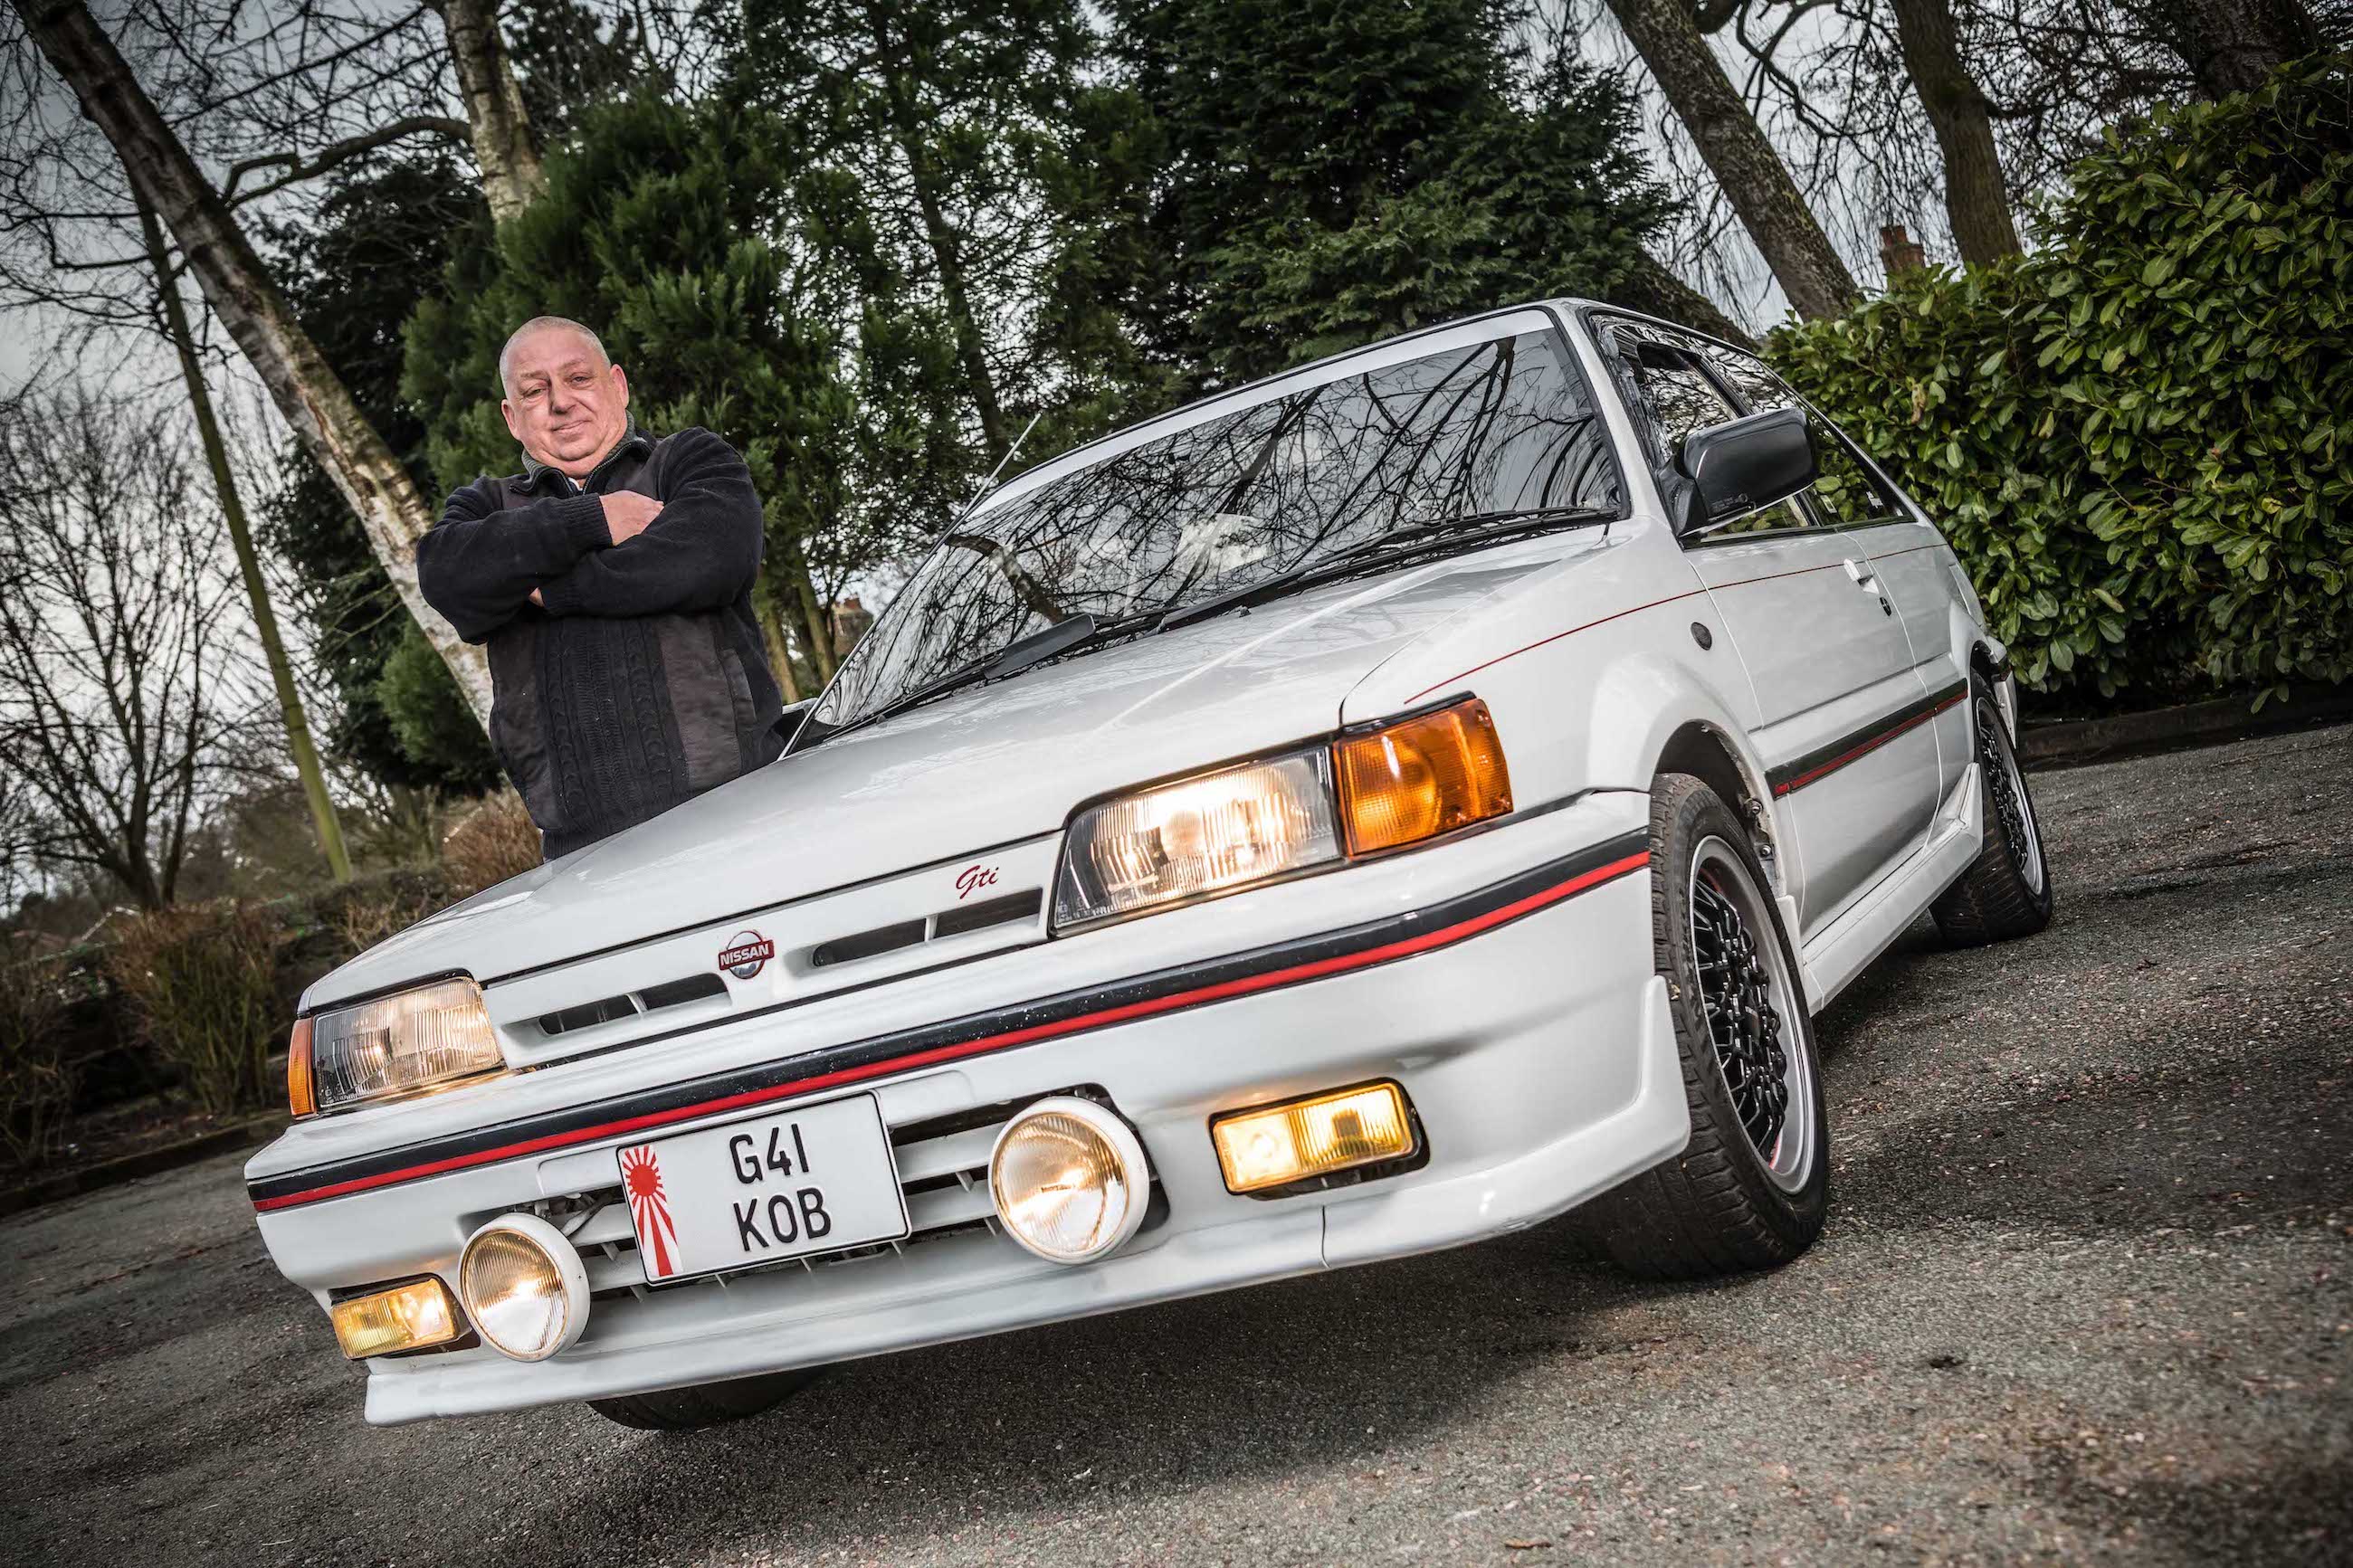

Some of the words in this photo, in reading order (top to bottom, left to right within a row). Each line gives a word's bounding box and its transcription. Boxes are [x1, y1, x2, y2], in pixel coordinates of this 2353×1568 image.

[956, 865, 999, 898] Gti
[719, 944, 769, 966] NISSAN
[733, 1187, 832, 1252] KOB
